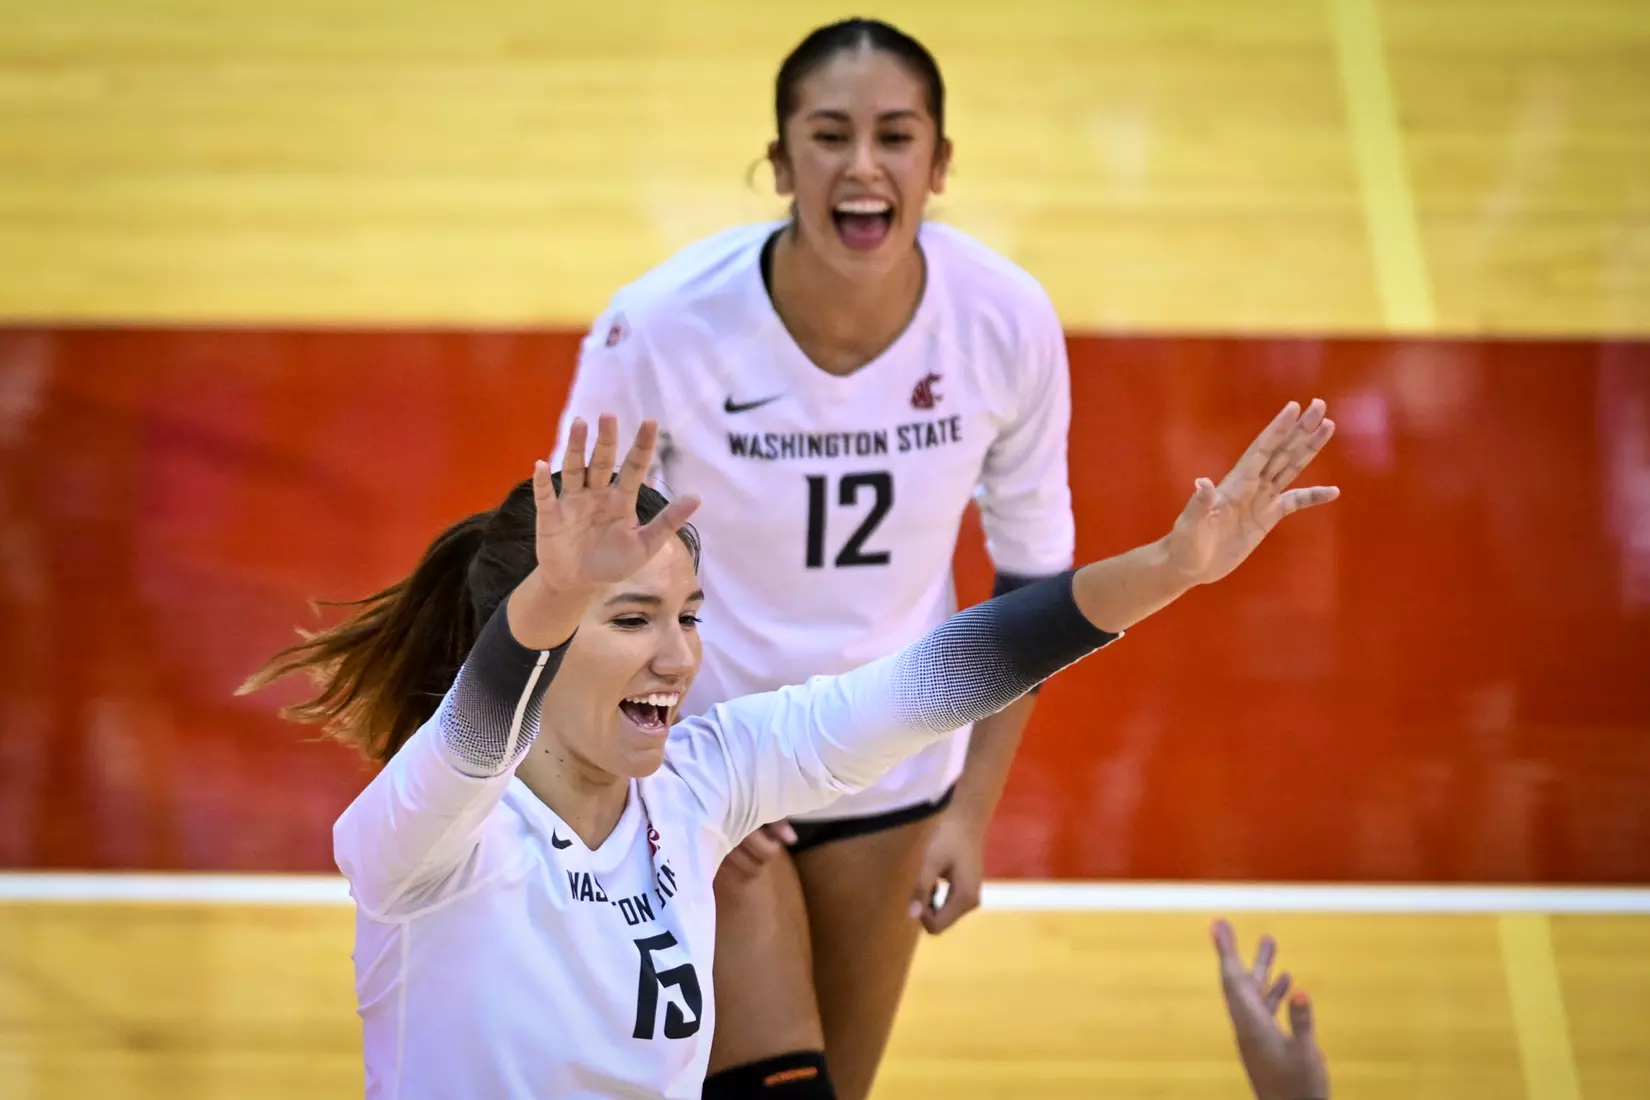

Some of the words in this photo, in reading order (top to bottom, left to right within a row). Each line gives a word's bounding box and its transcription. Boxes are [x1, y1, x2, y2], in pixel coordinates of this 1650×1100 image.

[727, 430, 888, 459] WASHINGTON
[896, 415, 962, 452] STATE
[804, 470, 894, 568] 12
[632, 930, 703, 1040] 15
